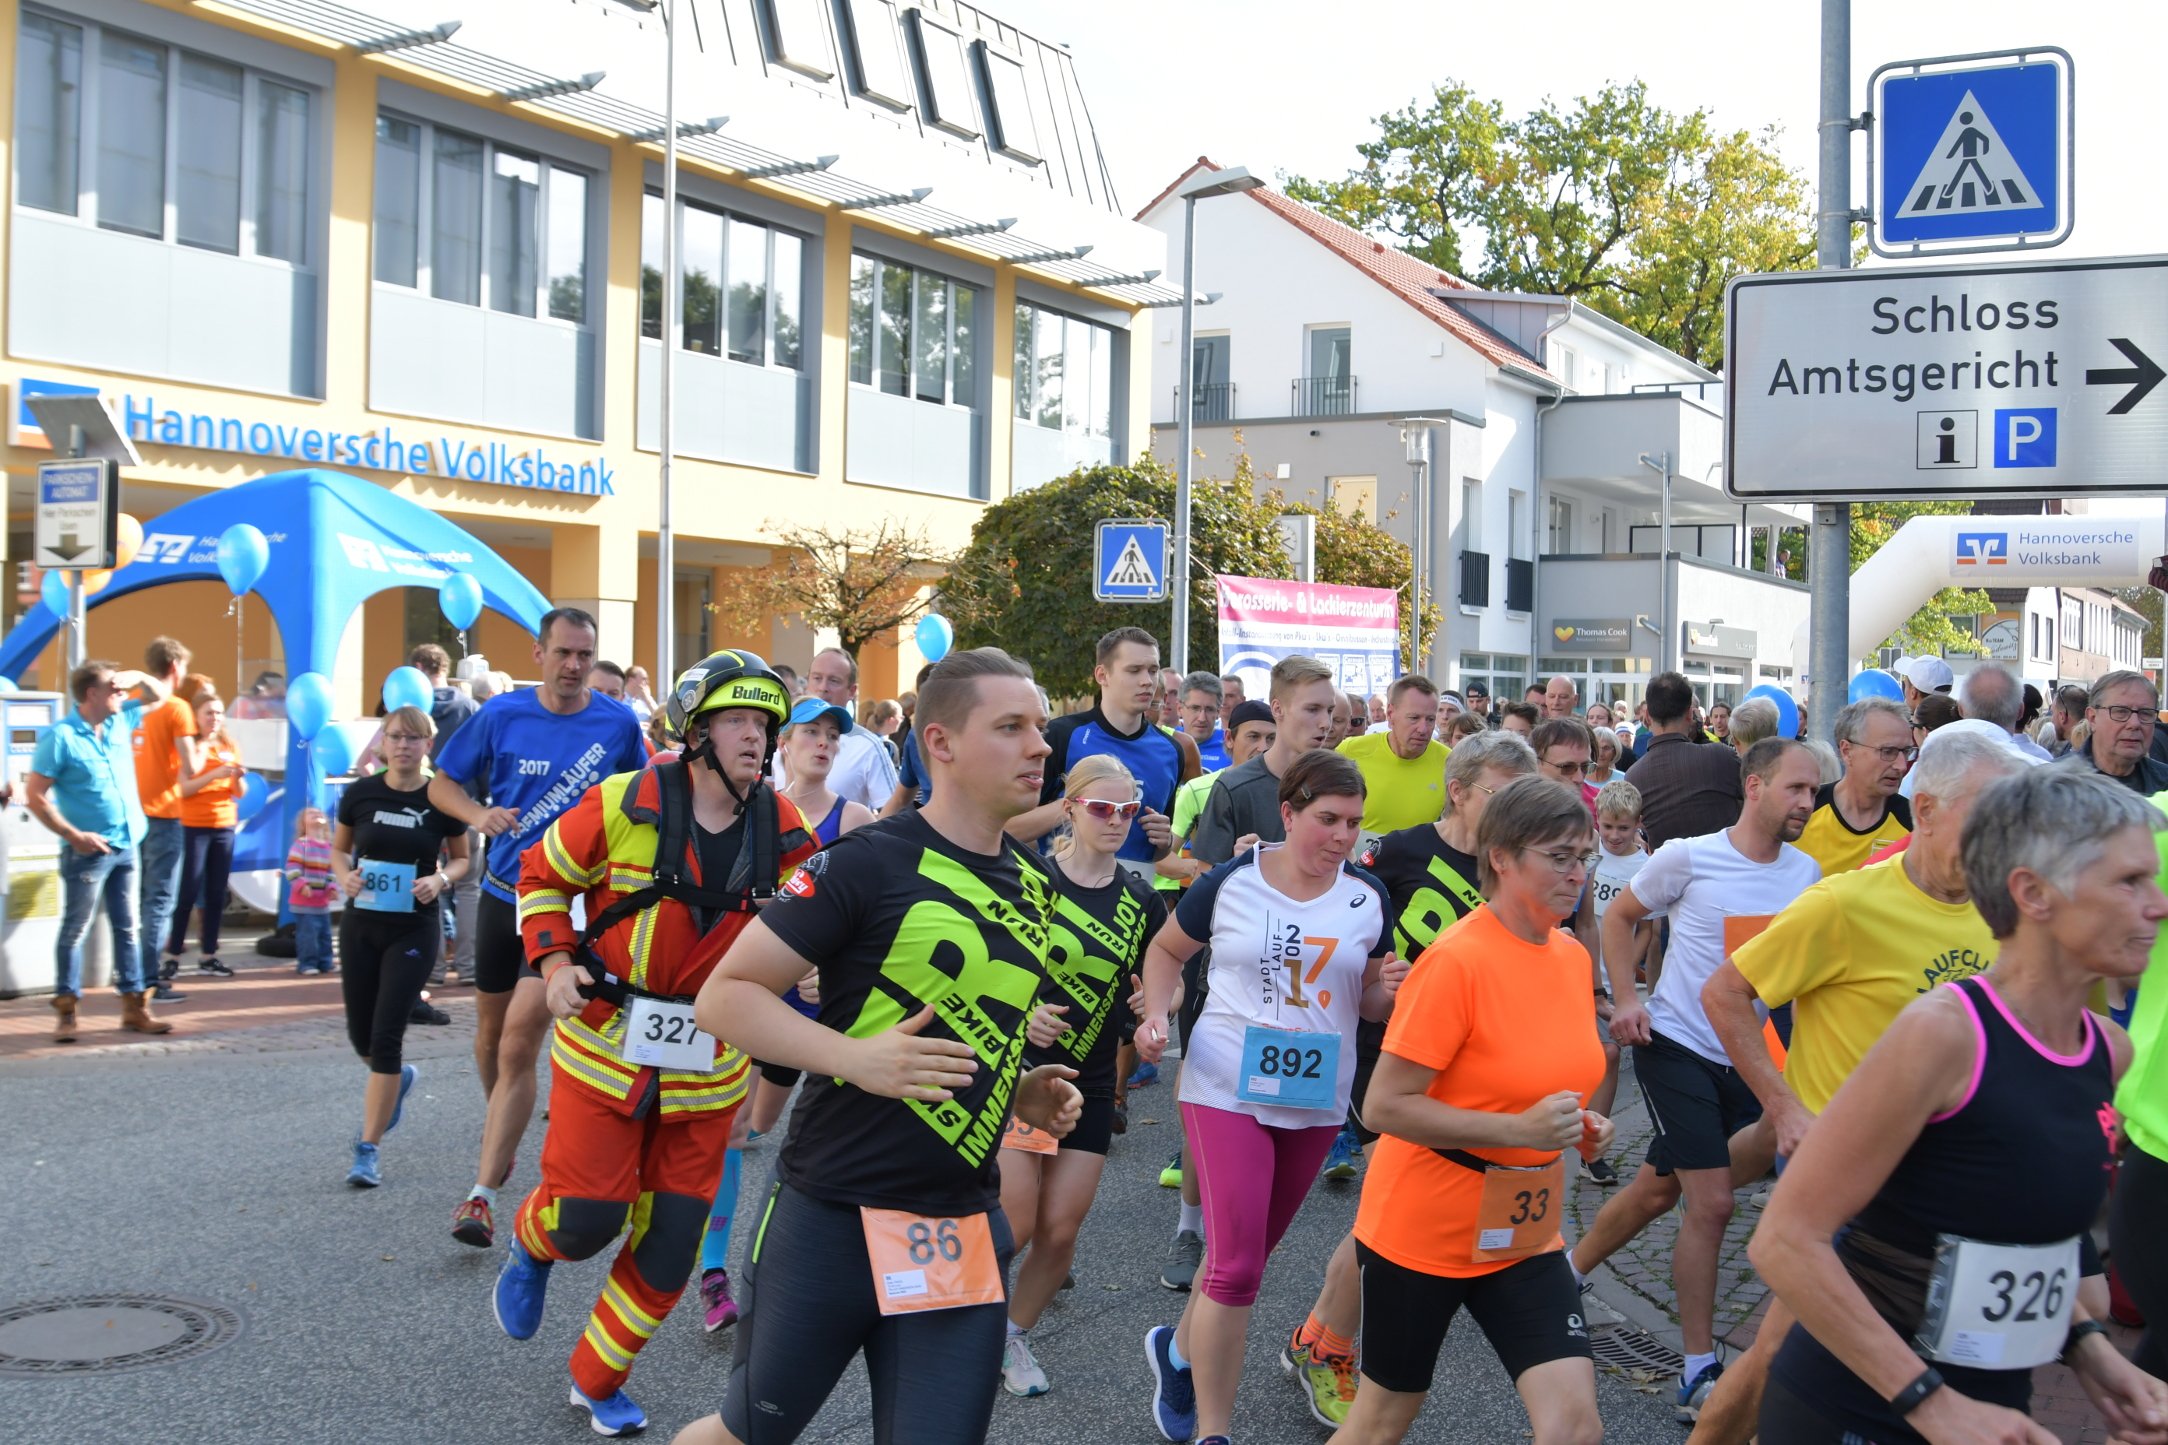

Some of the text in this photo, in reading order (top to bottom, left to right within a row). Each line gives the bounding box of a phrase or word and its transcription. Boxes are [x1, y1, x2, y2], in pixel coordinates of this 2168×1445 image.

[1871, 294, 2059, 335] Schloss
[1768, 349, 2059, 402] Amtsgericht
[123, 393, 616, 497] Hannoversche Volksbank
[2008, 416, 2042, 461] P
[2019, 531, 2134, 545] Hannoversche
[2018, 551, 2101, 565] Volksbank
[1576, 627, 1628, 637] Thomas Cook
[732, 685, 780, 706] Bullard
[518, 758, 550, 776] 2017
[373, 810, 417, 829] PUMA
[365, 872, 401, 893] 861
[1113, 886, 1142, 940] JOY
[1087, 921, 1126, 952] RUN
[1271, 934, 1283, 971] LAUF
[1057, 971, 1096, 1005] BIKE
[1260, 957, 1273, 1005] STADT
[1916, 949, 1990, 994] AUFCL
[644, 1013, 698, 1046] 327
[940, 993, 1005, 1055] BIKE
[1071, 976, 1121, 1063] IMMENSEN
[1259, 1045, 1322, 1080] 892
[1510, 1188, 1550, 1225] 33
[907, 1219, 963, 1266] 86
[1982, 1267, 2067, 1322] 326
